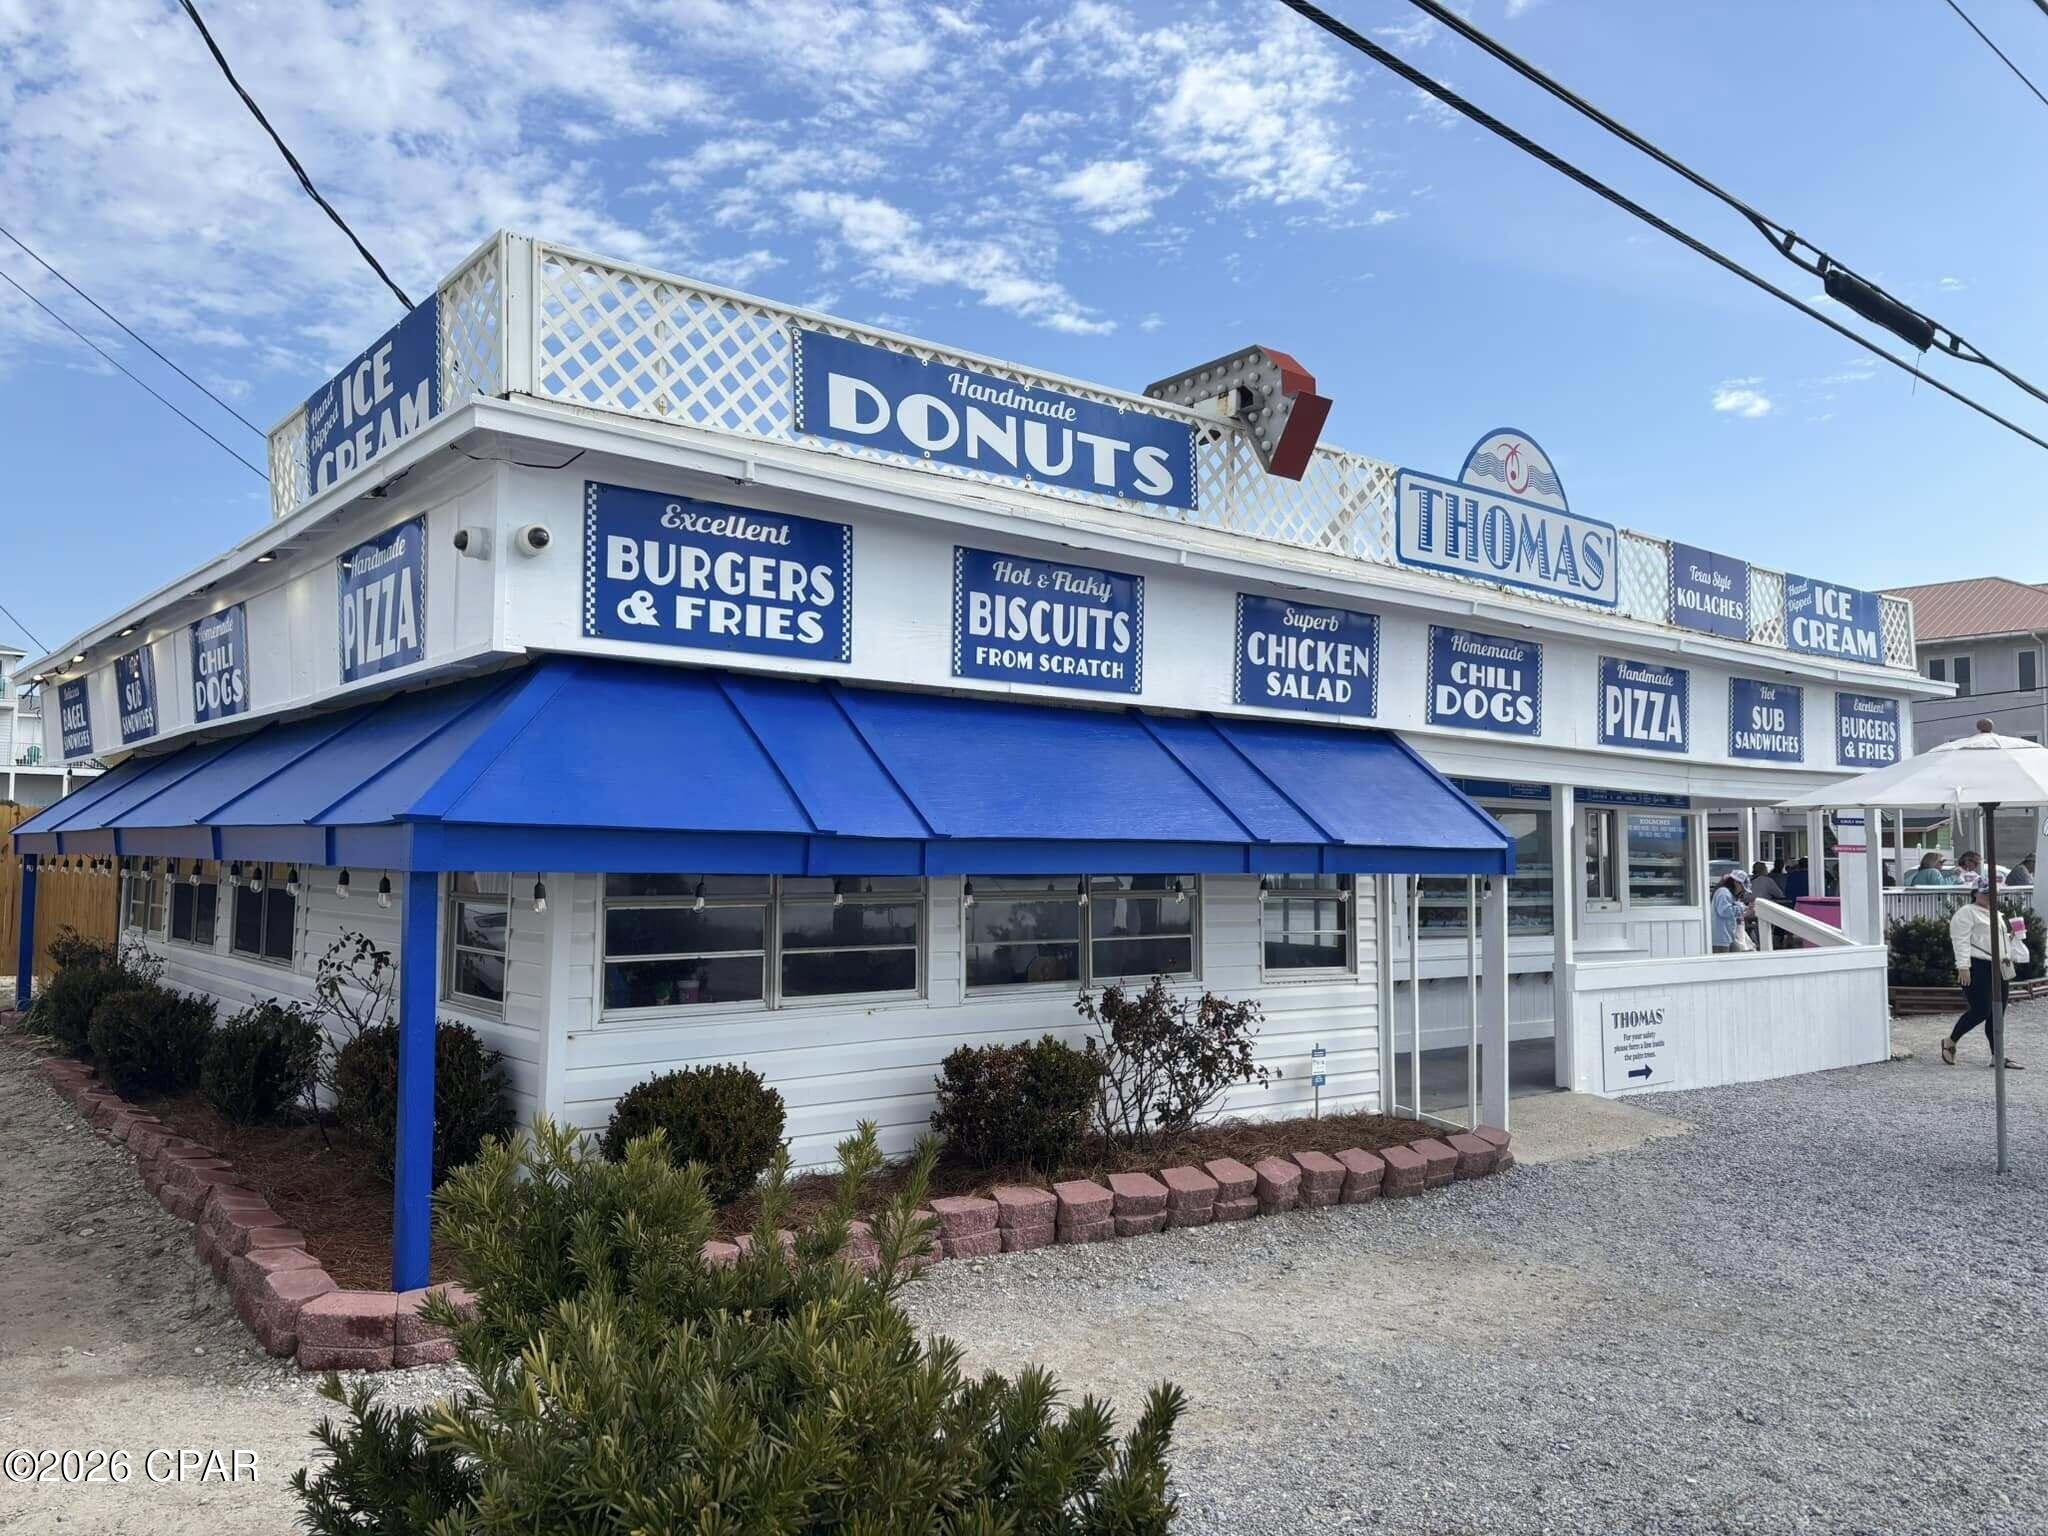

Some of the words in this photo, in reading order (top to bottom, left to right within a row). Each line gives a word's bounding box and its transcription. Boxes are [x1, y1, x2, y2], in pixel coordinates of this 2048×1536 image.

[342, 340, 394, 429] ICE
[948, 372, 1078, 422] Handmade
[311, 384, 334, 430] Hand
[312, 402, 339, 456] Dipped
[317, 378, 430, 493] CREAM
[828, 372, 1173, 496] DONUTS
[660, 503, 791, 545] Excellent
[1408, 483, 1611, 591] THOMAS'
[351, 536, 406, 578] Handmade
[607, 534, 834, 606] BURGERS
[992, 561, 1031, 586] Hot
[1037, 574, 1049, 588] &
[1052, 571, 1112, 603] Flaky
[1690, 565, 1711, 584] Texas
[1712, 571, 1732, 592] Style
[1788, 581, 1808, 597] Hand
[343, 566, 417, 670] PIZZA
[617, 590, 660, 626] &
[675, 595, 824, 644] FRIES
[1283, 607, 1339, 632] Superb
[1678, 587, 1743, 620] KOLACHES
[1788, 594, 1812, 613] Dipped
[1815, 586, 1853, 621] ICE
[969, 591, 1130, 653] BISCUITS
[1792, 617, 1877, 658] CREAM
[199, 642, 234, 676] CHILI
[976, 647, 1033, 670] FROM
[1040, 654, 1123, 679] SCRATCH
[1248, 631, 1369, 677] CHICKEN
[1450, 635, 1524, 661] Homemade
[195, 669, 244, 712] DOGS
[1267, 671, 1351, 703] SALAD
[1451, 661, 1521, 691] CHILI
[1617, 664, 1674, 686] Handmade
[125, 680, 143, 711] SUB
[1436, 684, 1534, 725] DOGS
[1760, 686, 1776, 700] Hot
[1853, 698, 1885, 714] Excellent
[63, 703, 87, 732] BAGEL
[1606, 685, 1682, 743] PIZZA
[1752, 705, 1785, 732] SUB
[1842, 716, 1896, 742] BURGERS
[1735, 731, 1799, 754] SANDWICHES
[1845, 741, 1855, 758] &
[1858, 742, 1895, 761] FRIES
[1611, 1008, 1665, 1029] THOMAS'
